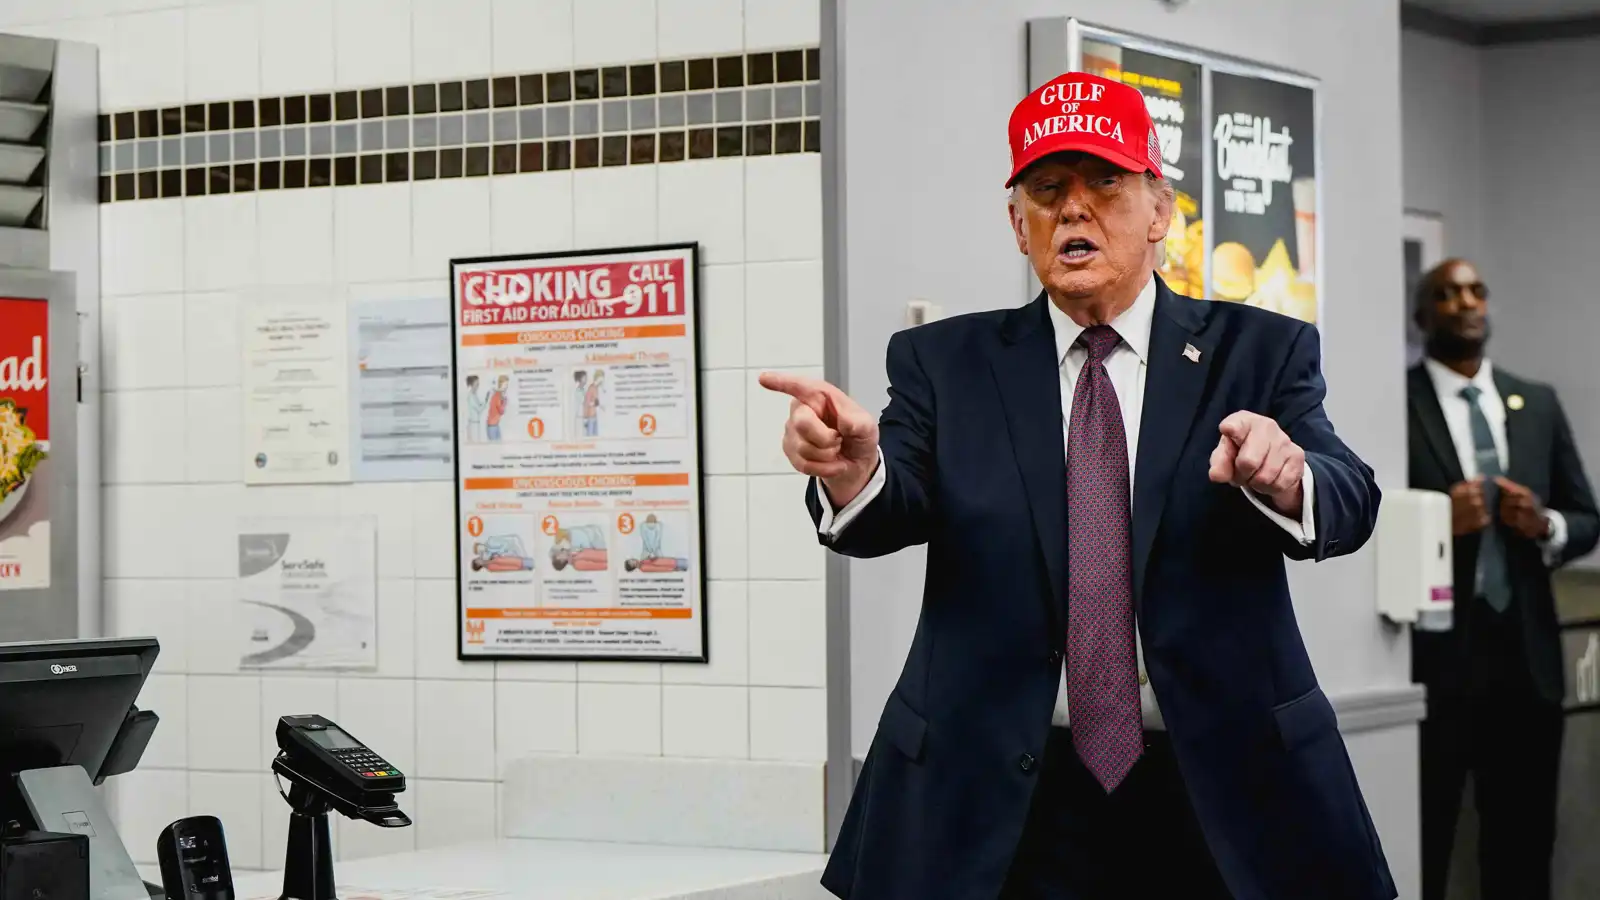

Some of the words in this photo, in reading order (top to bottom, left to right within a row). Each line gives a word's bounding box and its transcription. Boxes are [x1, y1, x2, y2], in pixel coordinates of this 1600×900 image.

[1040, 82, 1105, 105] GULF
[1061, 102, 1080, 114] OF
[1023, 114, 1125, 151] AMERICA
[628, 263, 674, 282] CALL
[465, 268, 611, 306] CHOKING
[623, 281, 677, 315] 911
[463, 309, 500, 324] FIRST
[502, 306, 528, 322] AID
[530, 304, 558, 320] FOR
[560, 301, 615, 319] ADULTS
[517, 329, 577, 343] CONSCIOUS
[578, 327, 625, 341] CHOKING
[513, 476, 587, 490] UNCONSCIOUS
[588, 475, 636, 488] CHOKING
